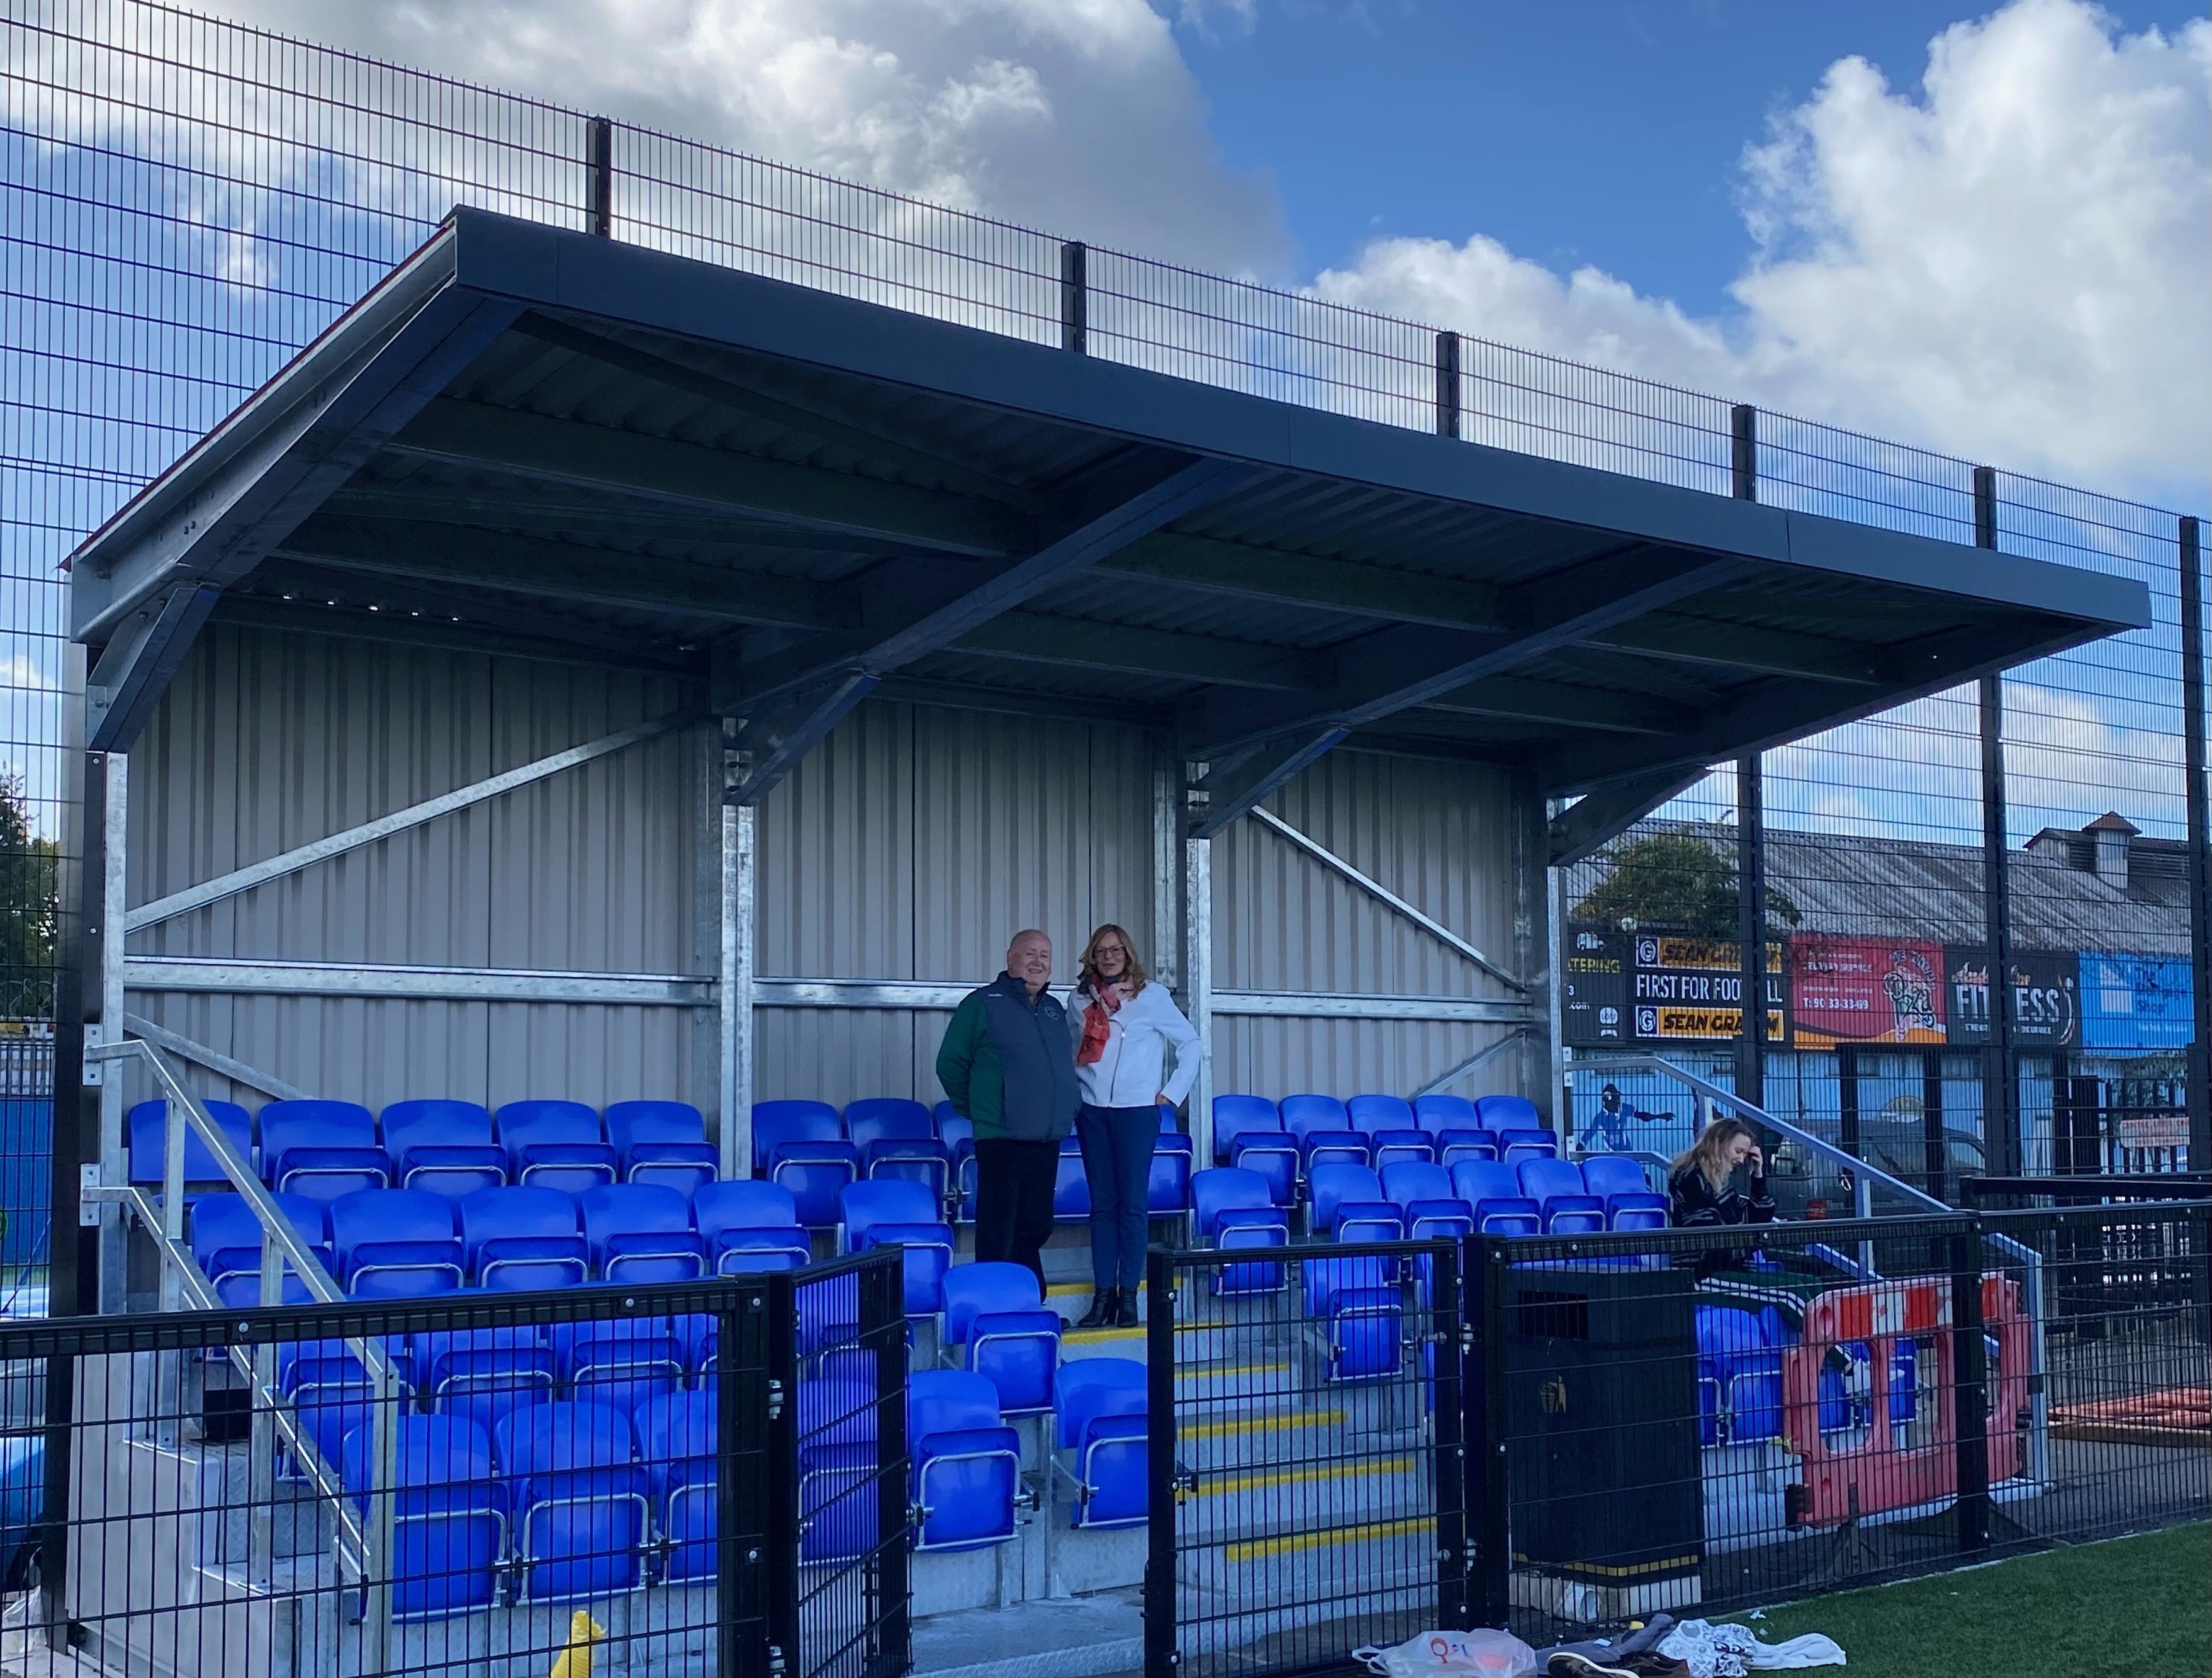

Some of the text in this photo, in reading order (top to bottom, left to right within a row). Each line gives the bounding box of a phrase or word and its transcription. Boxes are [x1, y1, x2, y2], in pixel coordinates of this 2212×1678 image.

[1637, 974, 1783, 1002] FIRST FOR FOOLL
[1957, 984, 2060, 1023] FITESS
[1663, 1014, 1709, 1030] SEAN
[1712, 1015, 1778, 1032] GRAM
